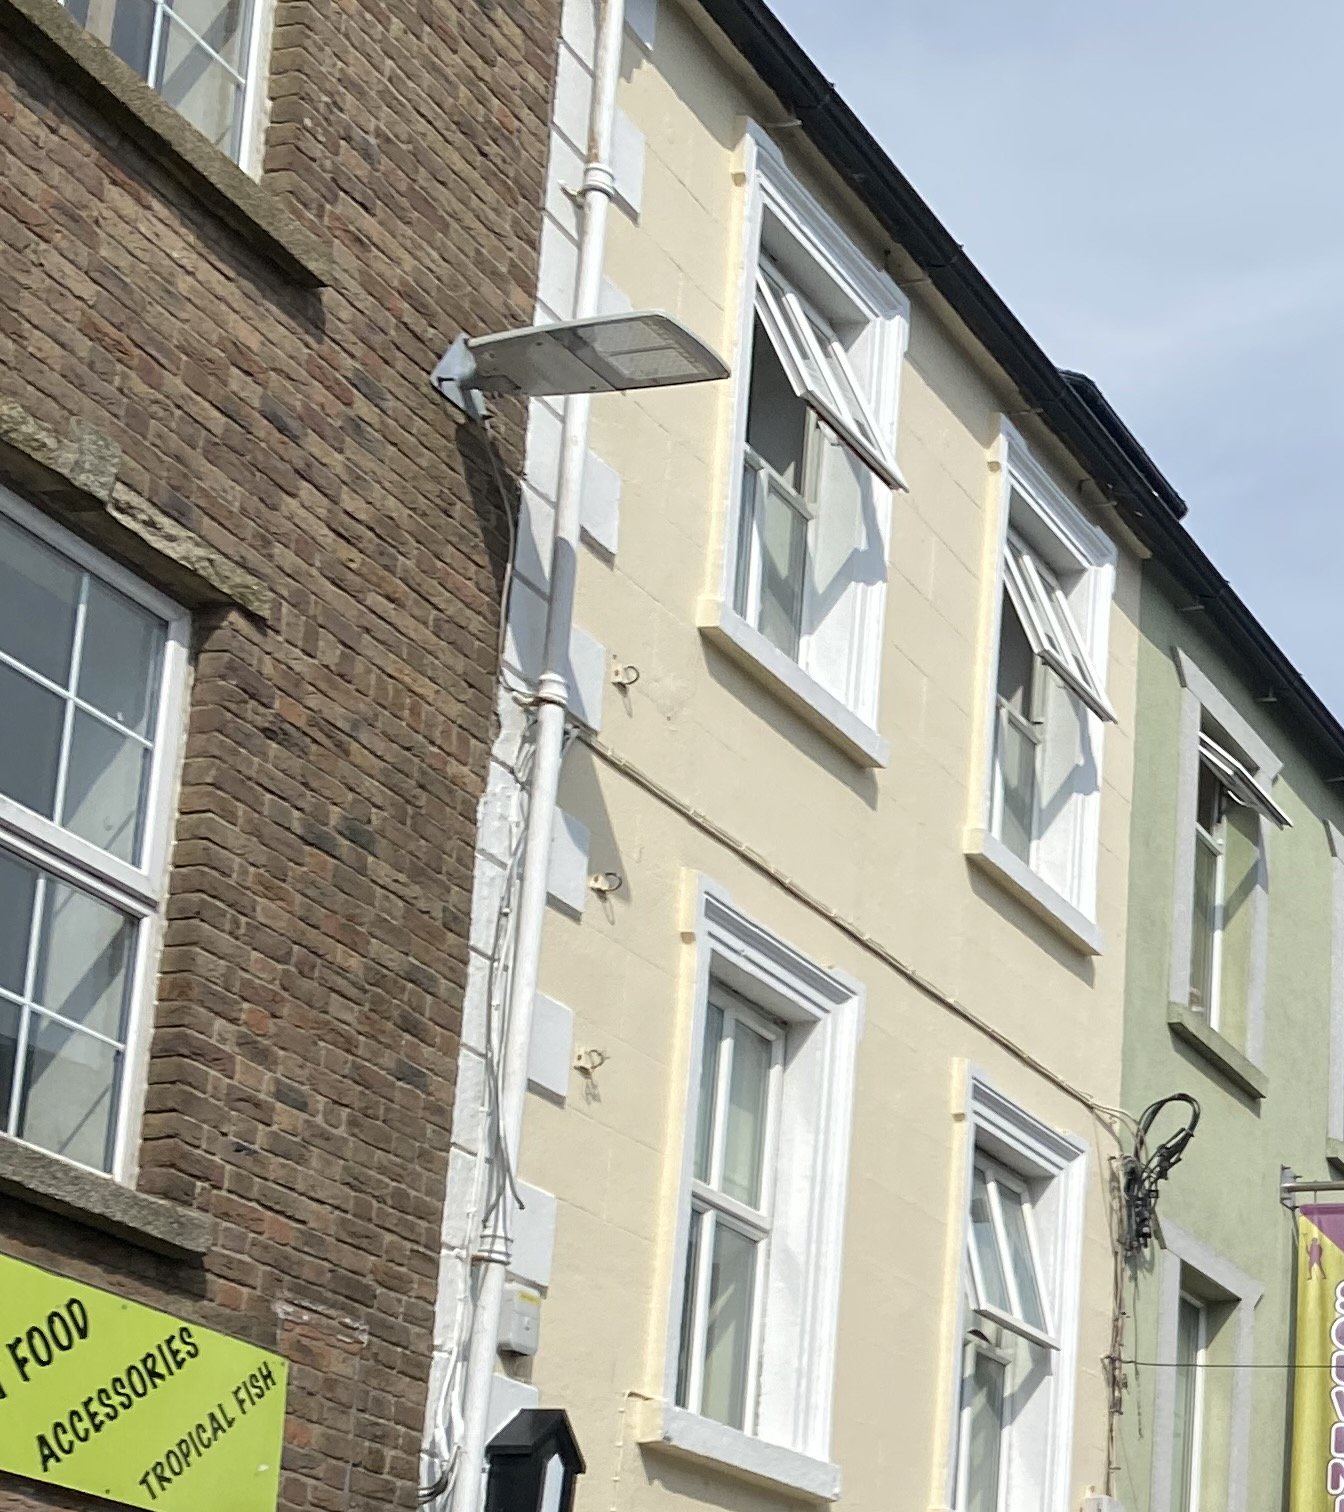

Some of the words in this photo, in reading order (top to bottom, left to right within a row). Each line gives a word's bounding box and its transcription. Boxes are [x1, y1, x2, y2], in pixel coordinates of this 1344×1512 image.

[6, 1298, 89, 1382] FOOD
[36, 1327, 200, 1473] ACCESSORIES
[139, 1404, 236, 1500] TROPICAL
[232, 1361, 278, 1415] FISH
